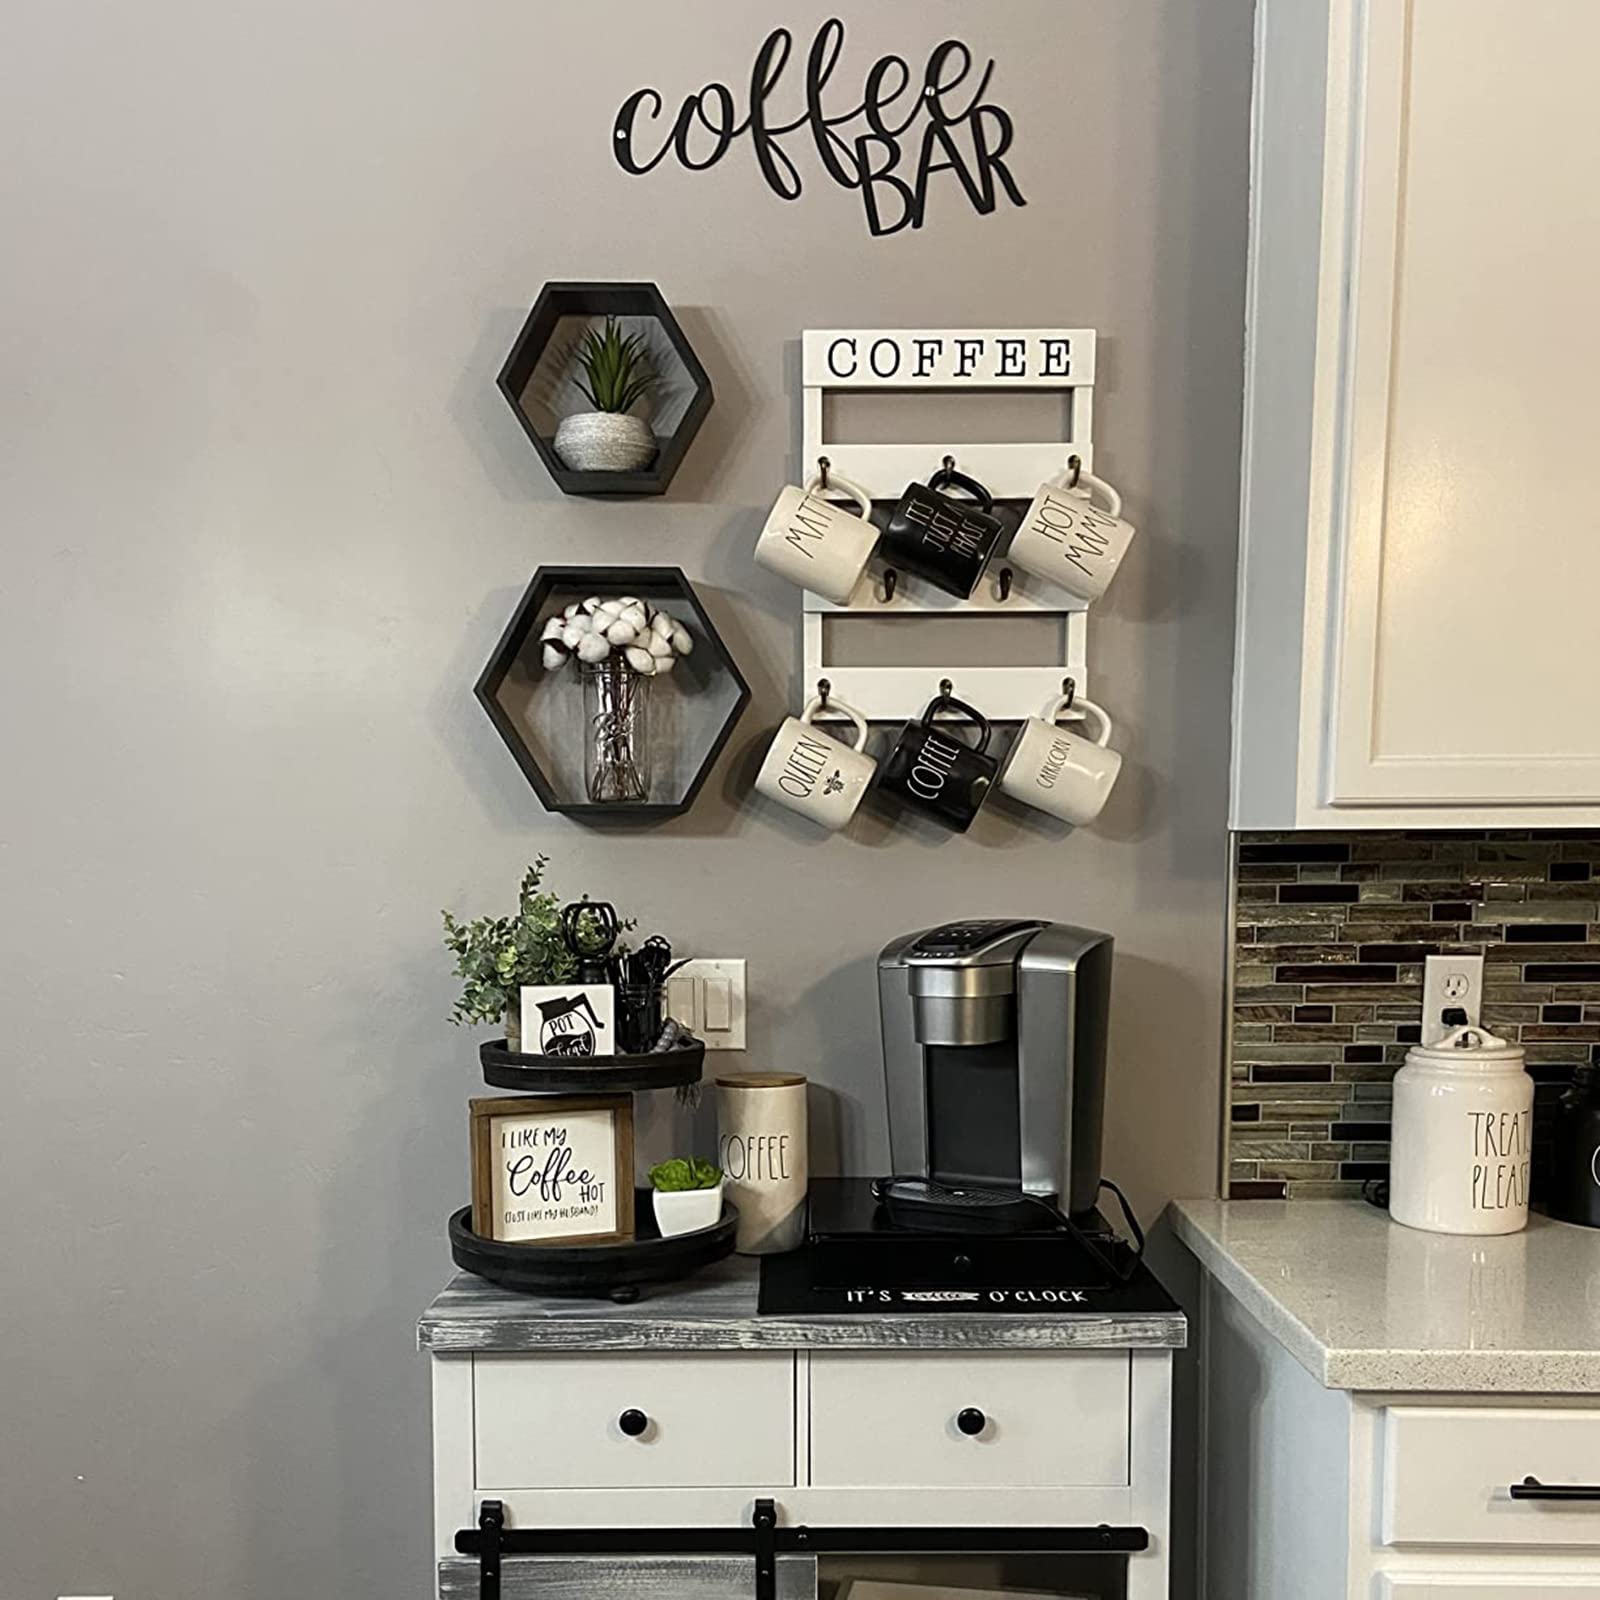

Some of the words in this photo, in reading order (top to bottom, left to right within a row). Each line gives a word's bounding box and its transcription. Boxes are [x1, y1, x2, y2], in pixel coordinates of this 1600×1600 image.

[612, 18, 994, 200] coffee
[855, 105, 1027, 236] BAR
[827, 338, 1070, 378] COFFEE
[785, 495, 838, 559] MATT
[905, 499, 935, 526] IT'S
[922, 512, 958, 552] JUST
[1031, 495, 1079, 543] HOT
[778, 733, 832, 797] QUEEN
[906, 735, 960, 799] COFFEE
[1036, 737, 1071, 789] CAPRICORN
[548, 1014, 574, 1037] POT
[502, 1132, 506, 1149] I
[510, 1128, 540, 1149] LIKE
[720, 1134, 790, 1180] COFFEE
[1467, 1110, 1530, 1157] TREAT
[507, 1147, 596, 1202] Coffee
[579, 1182, 605, 1203] HOT
[846, 1290, 892, 1303] IT'S
[988, 1290, 1089, 1303] O'CLOCK
